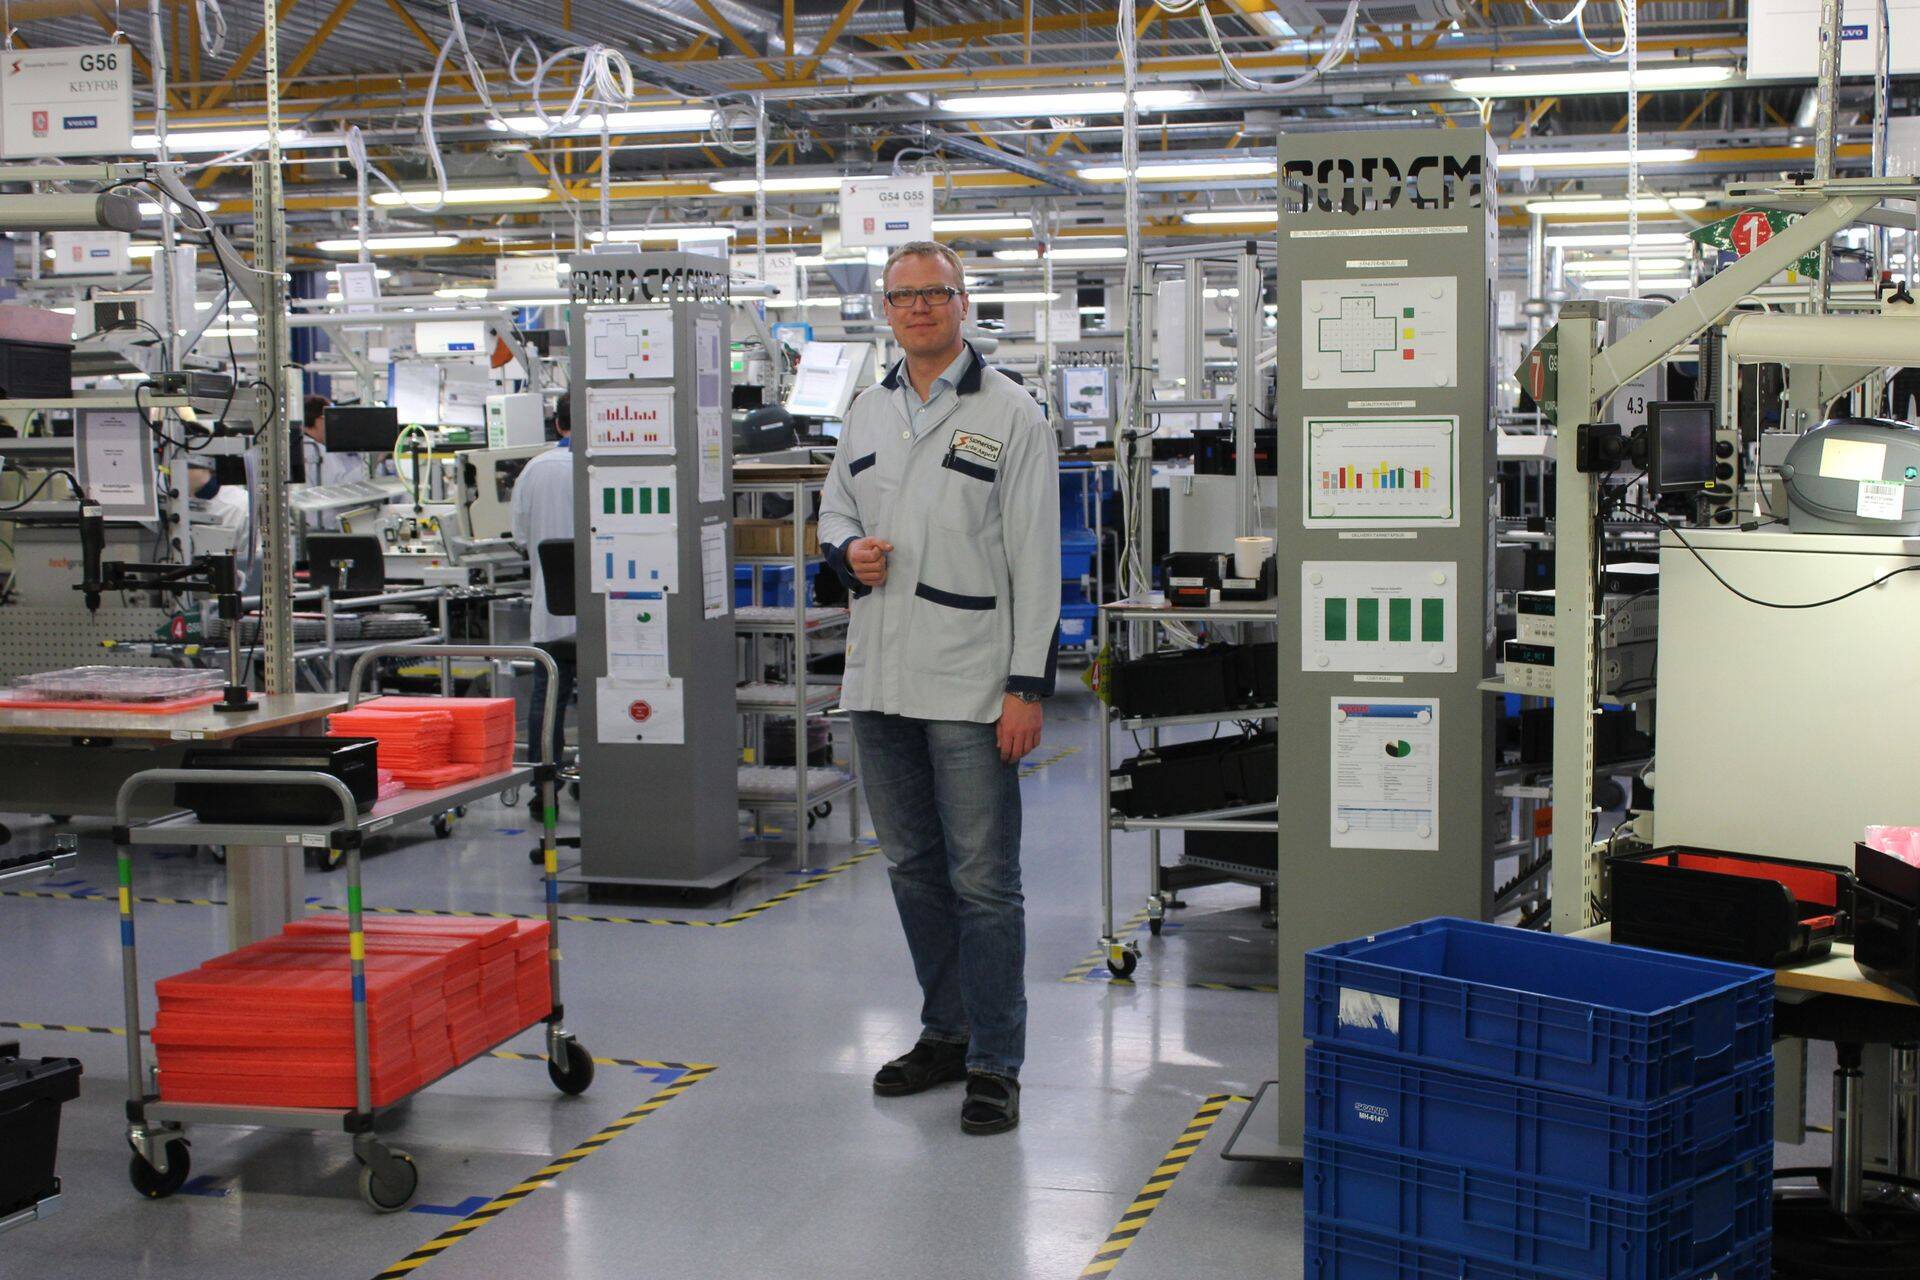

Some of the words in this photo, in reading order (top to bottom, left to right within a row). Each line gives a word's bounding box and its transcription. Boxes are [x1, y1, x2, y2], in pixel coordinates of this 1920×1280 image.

[80, 53, 118, 72] G56
[69, 80, 119, 93] KEYFOB
[1281, 154, 1482, 216] SQDCM
[879, 192, 900, 202] G54
[903, 190, 925, 201] G55
[1742, 215, 1760, 251] 1
[1531, 354, 1542, 398] 7
[1626, 396, 1644, 414] 4.3
[174, 620, 183, 638] 4
[1354, 1102, 1389, 1117] SCANIA
